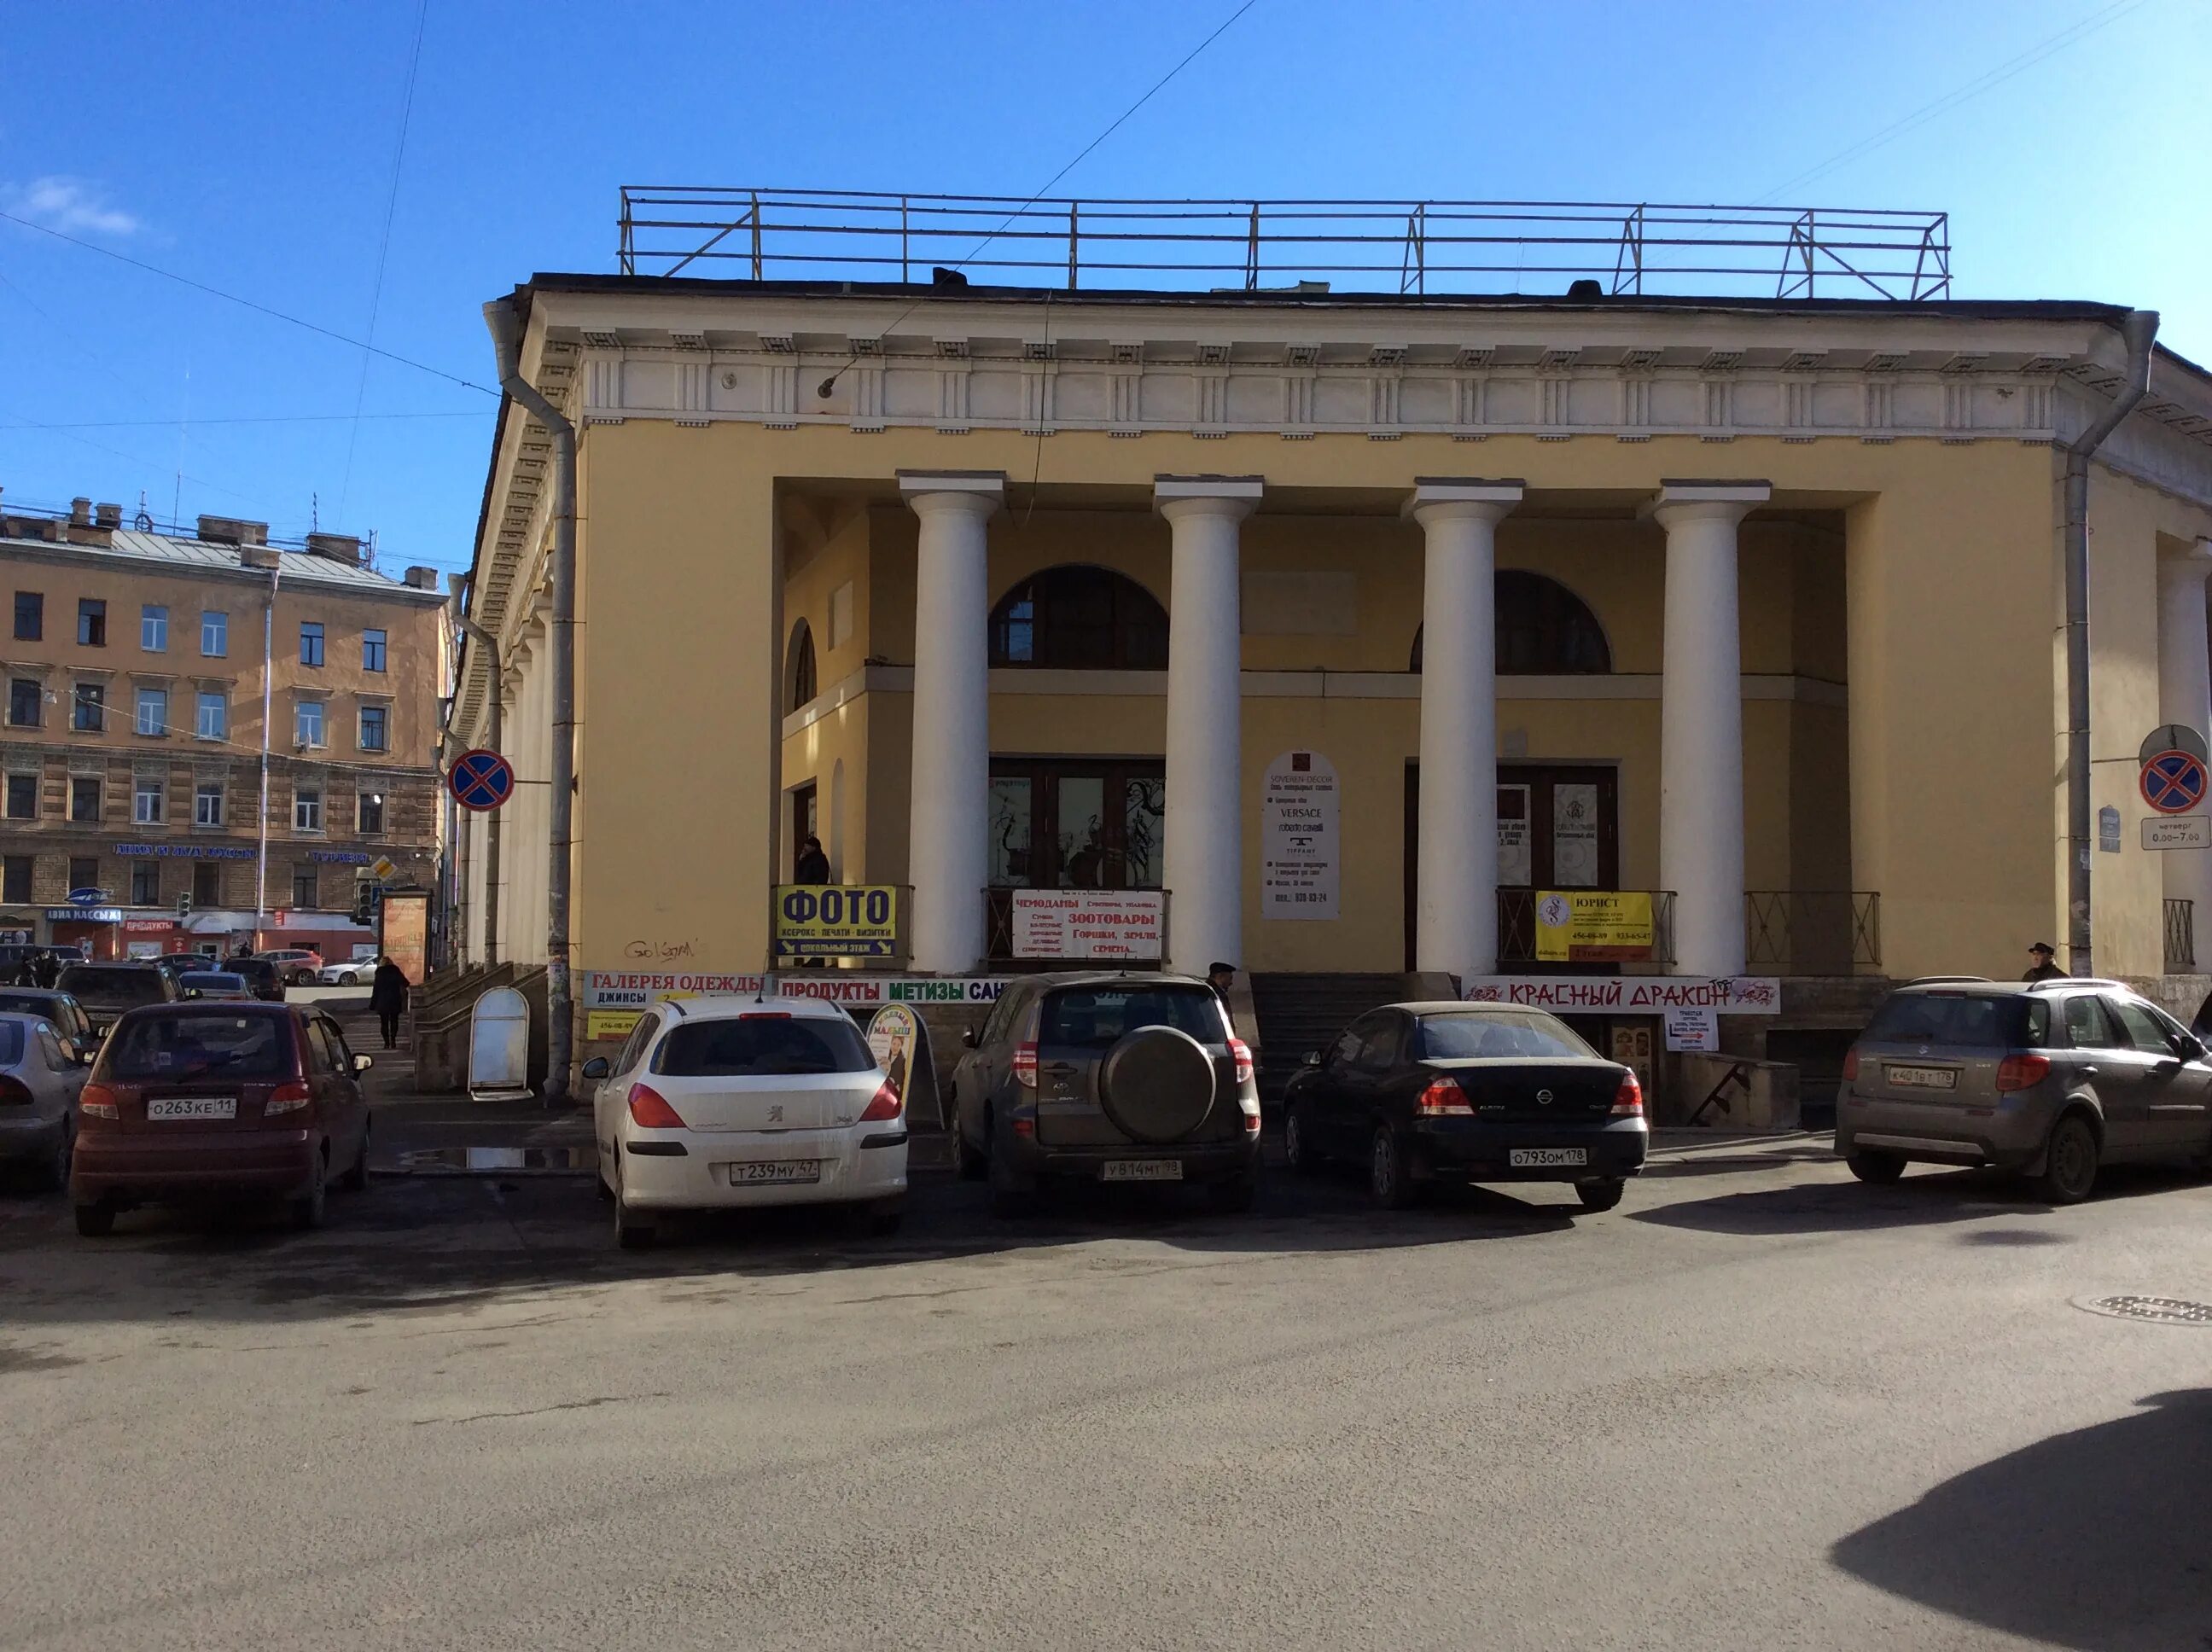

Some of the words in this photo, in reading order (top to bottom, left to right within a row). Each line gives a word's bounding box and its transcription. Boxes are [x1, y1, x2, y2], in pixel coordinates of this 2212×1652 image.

[1280, 808, 1322, 818] VERSACE
[783, 889, 889, 925] ФОТО
[1016, 899, 1080, 910] ЧЕМОДАНЫ
[1576, 897, 1620, 908] ЮРИСТ
[1068, 913, 1155, 925] ЗООТОВАРЫ
[822, 928, 851, 937] ПЕЧАТИ
[856, 928, 891, 937] ВИЗИТКИ
[800, 942, 848, 953] ЦОКОЛЬНЫЙ
[849, 944, 871, 953] ЭТАЖ
[591, 974, 675, 991] ГАЛЕРЕЯ
[679, 975, 765, 993] ОДЕЖДЫ
[782, 982, 880, 1000] ПРОДУКТЫ
[889, 982, 964, 1001] МЕТИЗЫ
[1509, 980, 1622, 1006] КРАСНЫЙ
[1629, 984, 1730, 1007] ДРАКОН
[597, 992, 647, 1003] ДЖИНСЫ
[218, 1099, 232, 1109] 11
[1565, 1149, 1585, 1160] 178
[799, 1161, 813, 1172] 47
